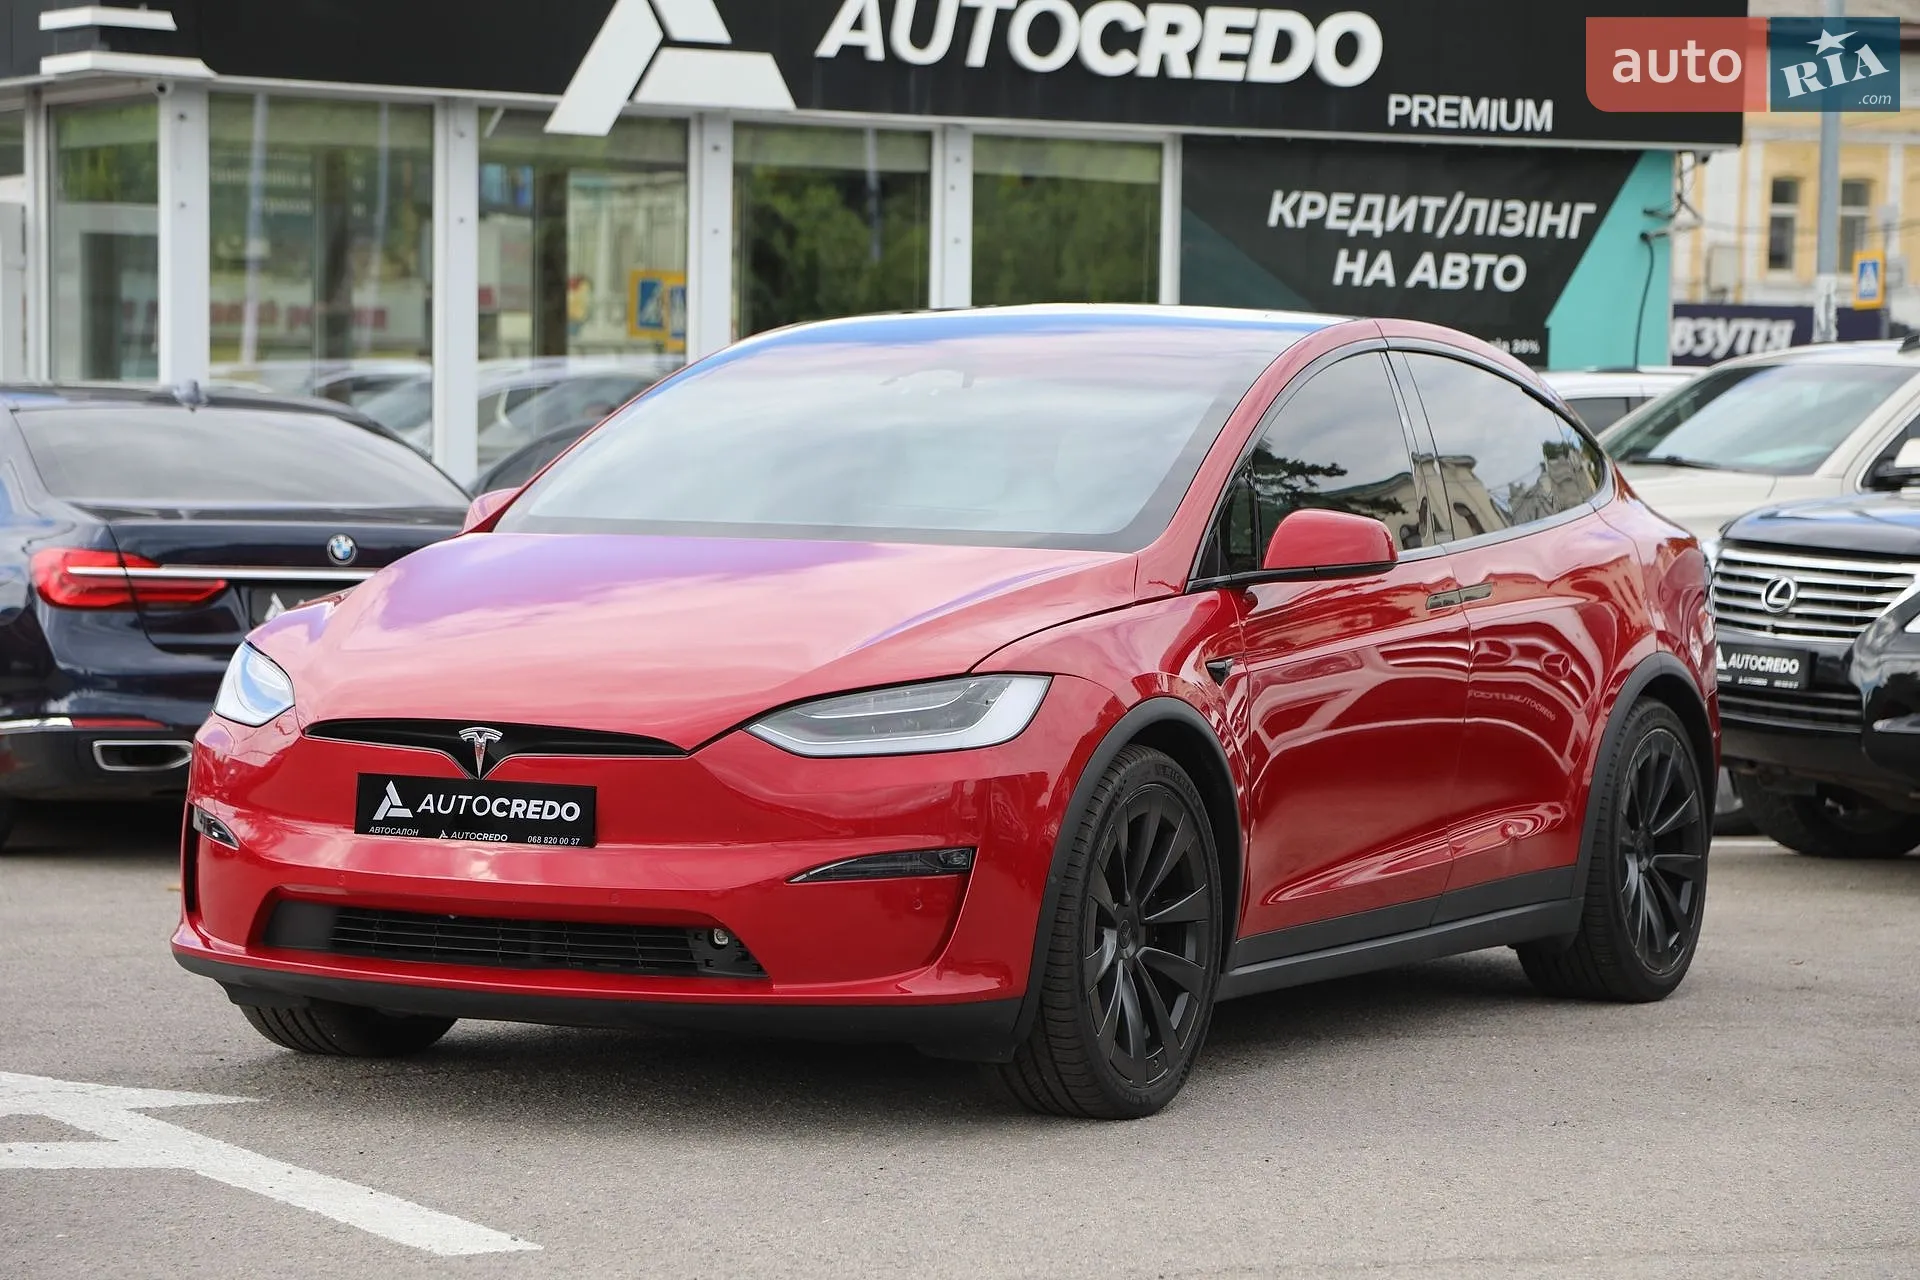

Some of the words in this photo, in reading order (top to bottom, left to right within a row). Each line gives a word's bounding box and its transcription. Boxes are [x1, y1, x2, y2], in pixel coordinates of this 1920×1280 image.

[815, 0, 1384, 88] AUTOCREDO
[1387, 93, 1554, 132] PREMIUM
[1267, 189, 1598, 239] КРЕДИТ/ЛІЗІНГ
[1332, 249, 1397, 287] НА
[1405, 251, 1528, 292] АВТО
[1728, 652, 1799, 675] AUTOCREDO
[416, 793, 581, 822] AUTOCREDO
[368, 826, 419, 837] АВТОСАЛОН
[450, 831, 508, 842] AUTOCREDO
[527, 835, 542, 844] 068
[543, 836, 558, 845] 820
[559, 837, 570, 845] 00
[571, 838, 580, 846] 37
